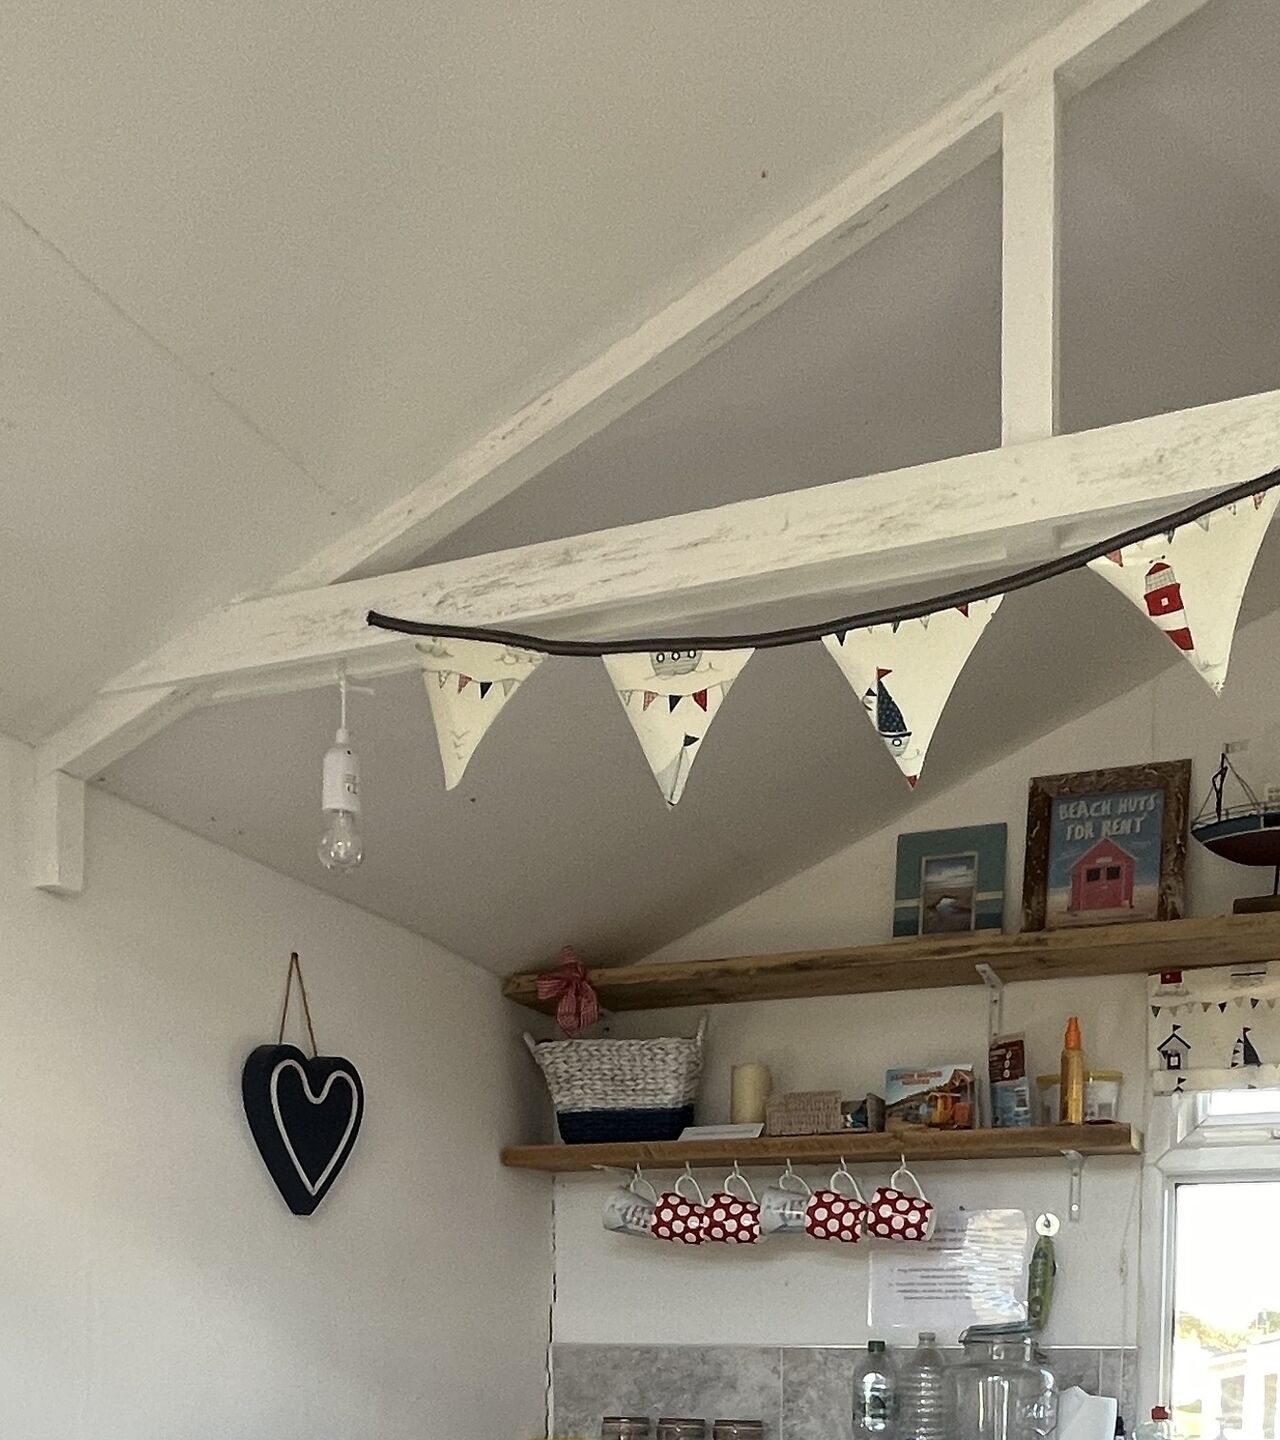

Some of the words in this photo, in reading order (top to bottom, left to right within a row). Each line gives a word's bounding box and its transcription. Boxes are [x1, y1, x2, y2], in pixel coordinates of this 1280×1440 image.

[1059, 800, 1111, 820] BEACH
[1118, 793, 1158, 814] HUTS
[1065, 822, 1095, 841] FOR
[1102, 815, 1146, 836] RENT
